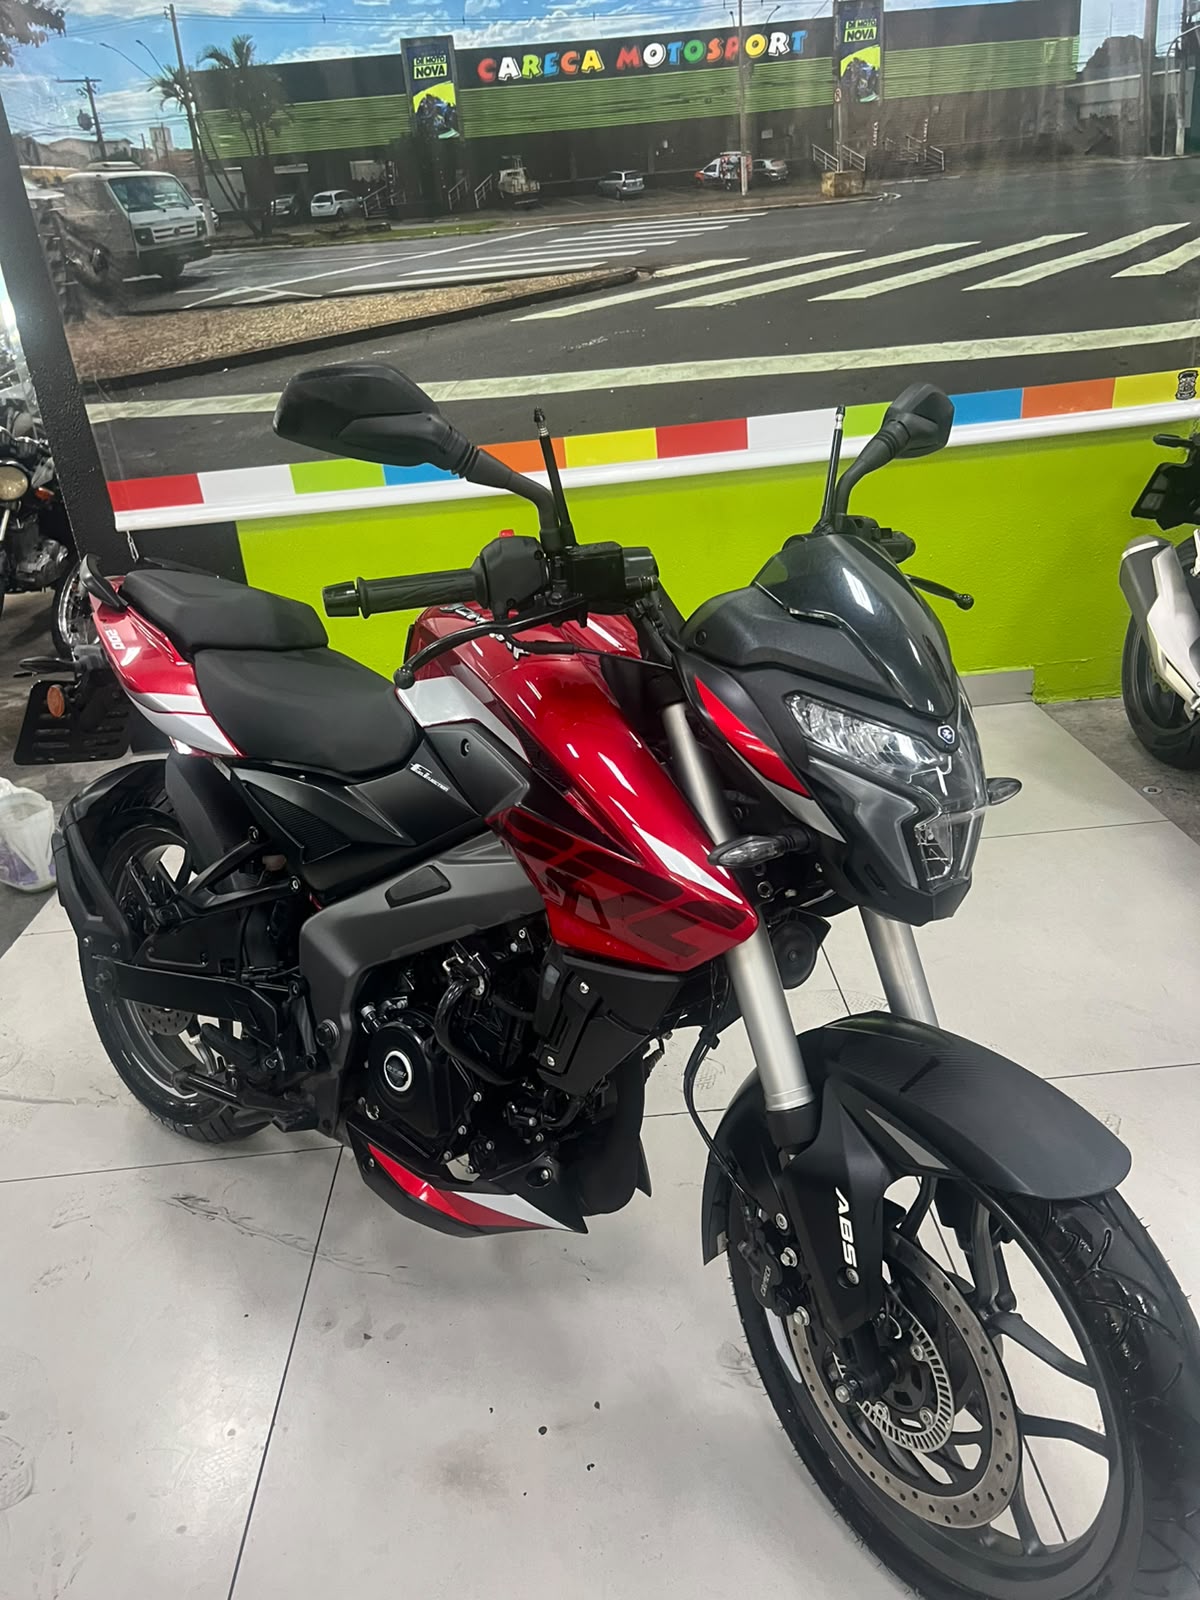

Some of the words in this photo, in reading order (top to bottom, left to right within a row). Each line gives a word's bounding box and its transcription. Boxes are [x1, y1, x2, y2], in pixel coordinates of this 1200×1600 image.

[846, 29, 875, 41] NOVA
[415, 65, 446, 77] NOVA
[477, 49, 605, 82] CARECA
[616, 30, 808, 70] MOTOSPORT
[835, 1186, 858, 1268] ABS
